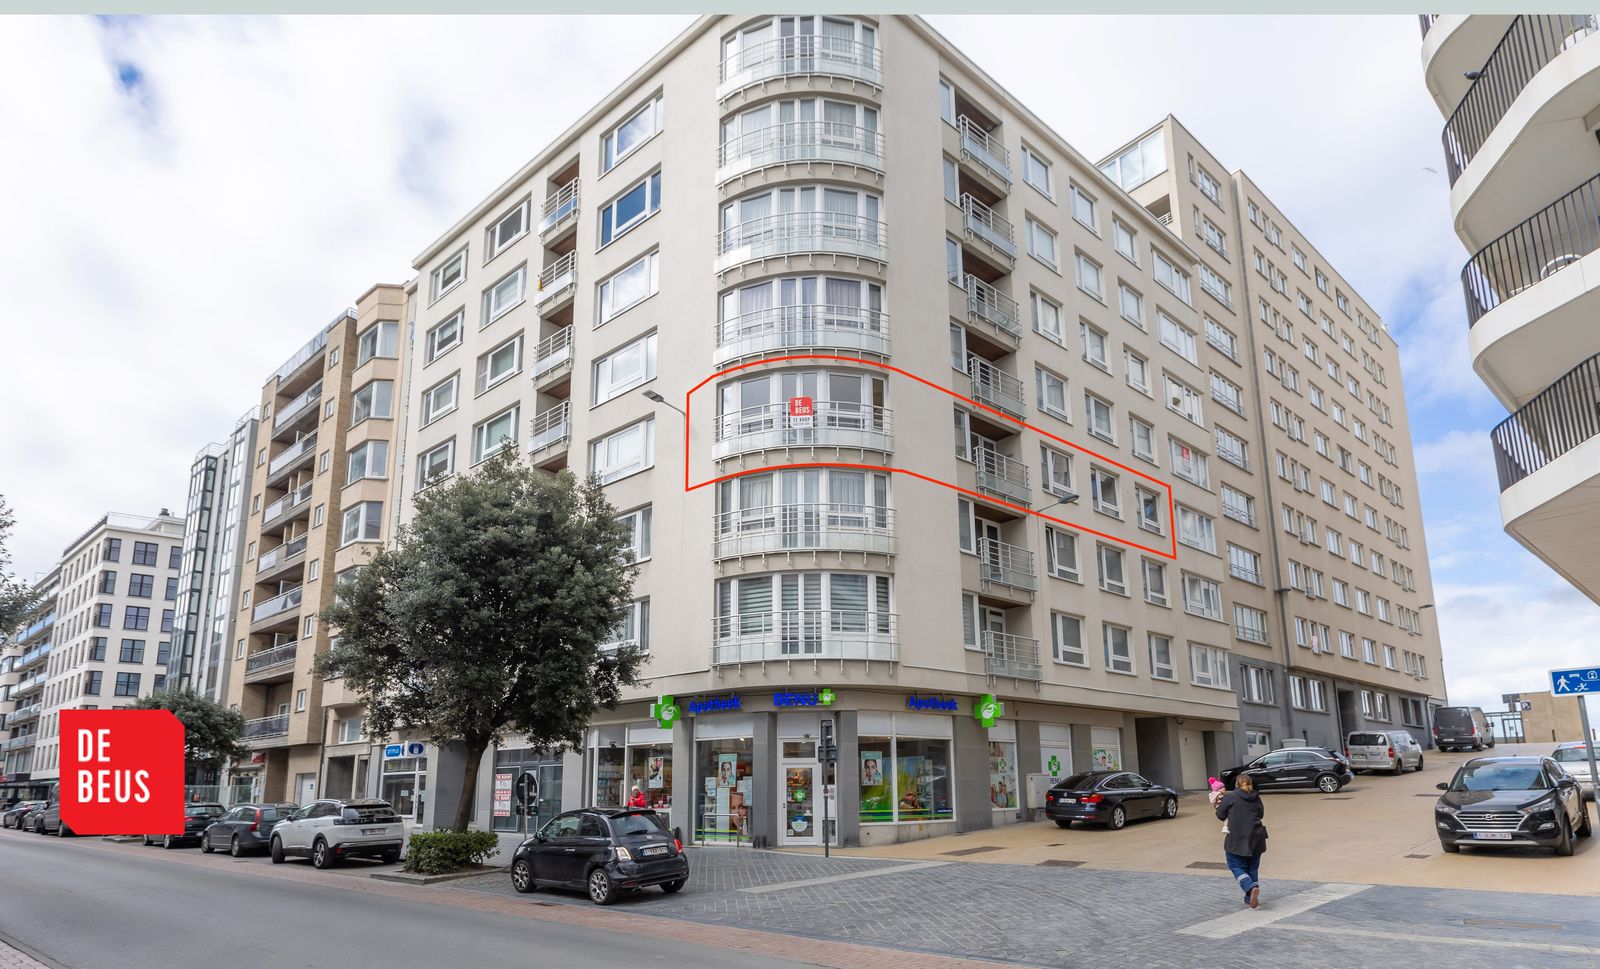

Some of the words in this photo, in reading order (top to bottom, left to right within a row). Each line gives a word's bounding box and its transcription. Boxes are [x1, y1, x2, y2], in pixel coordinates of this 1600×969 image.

[688, 695, 742, 715] Apotheek
[773, 692, 818, 707] BENU
[908, 694, 959, 711] Apotheek
